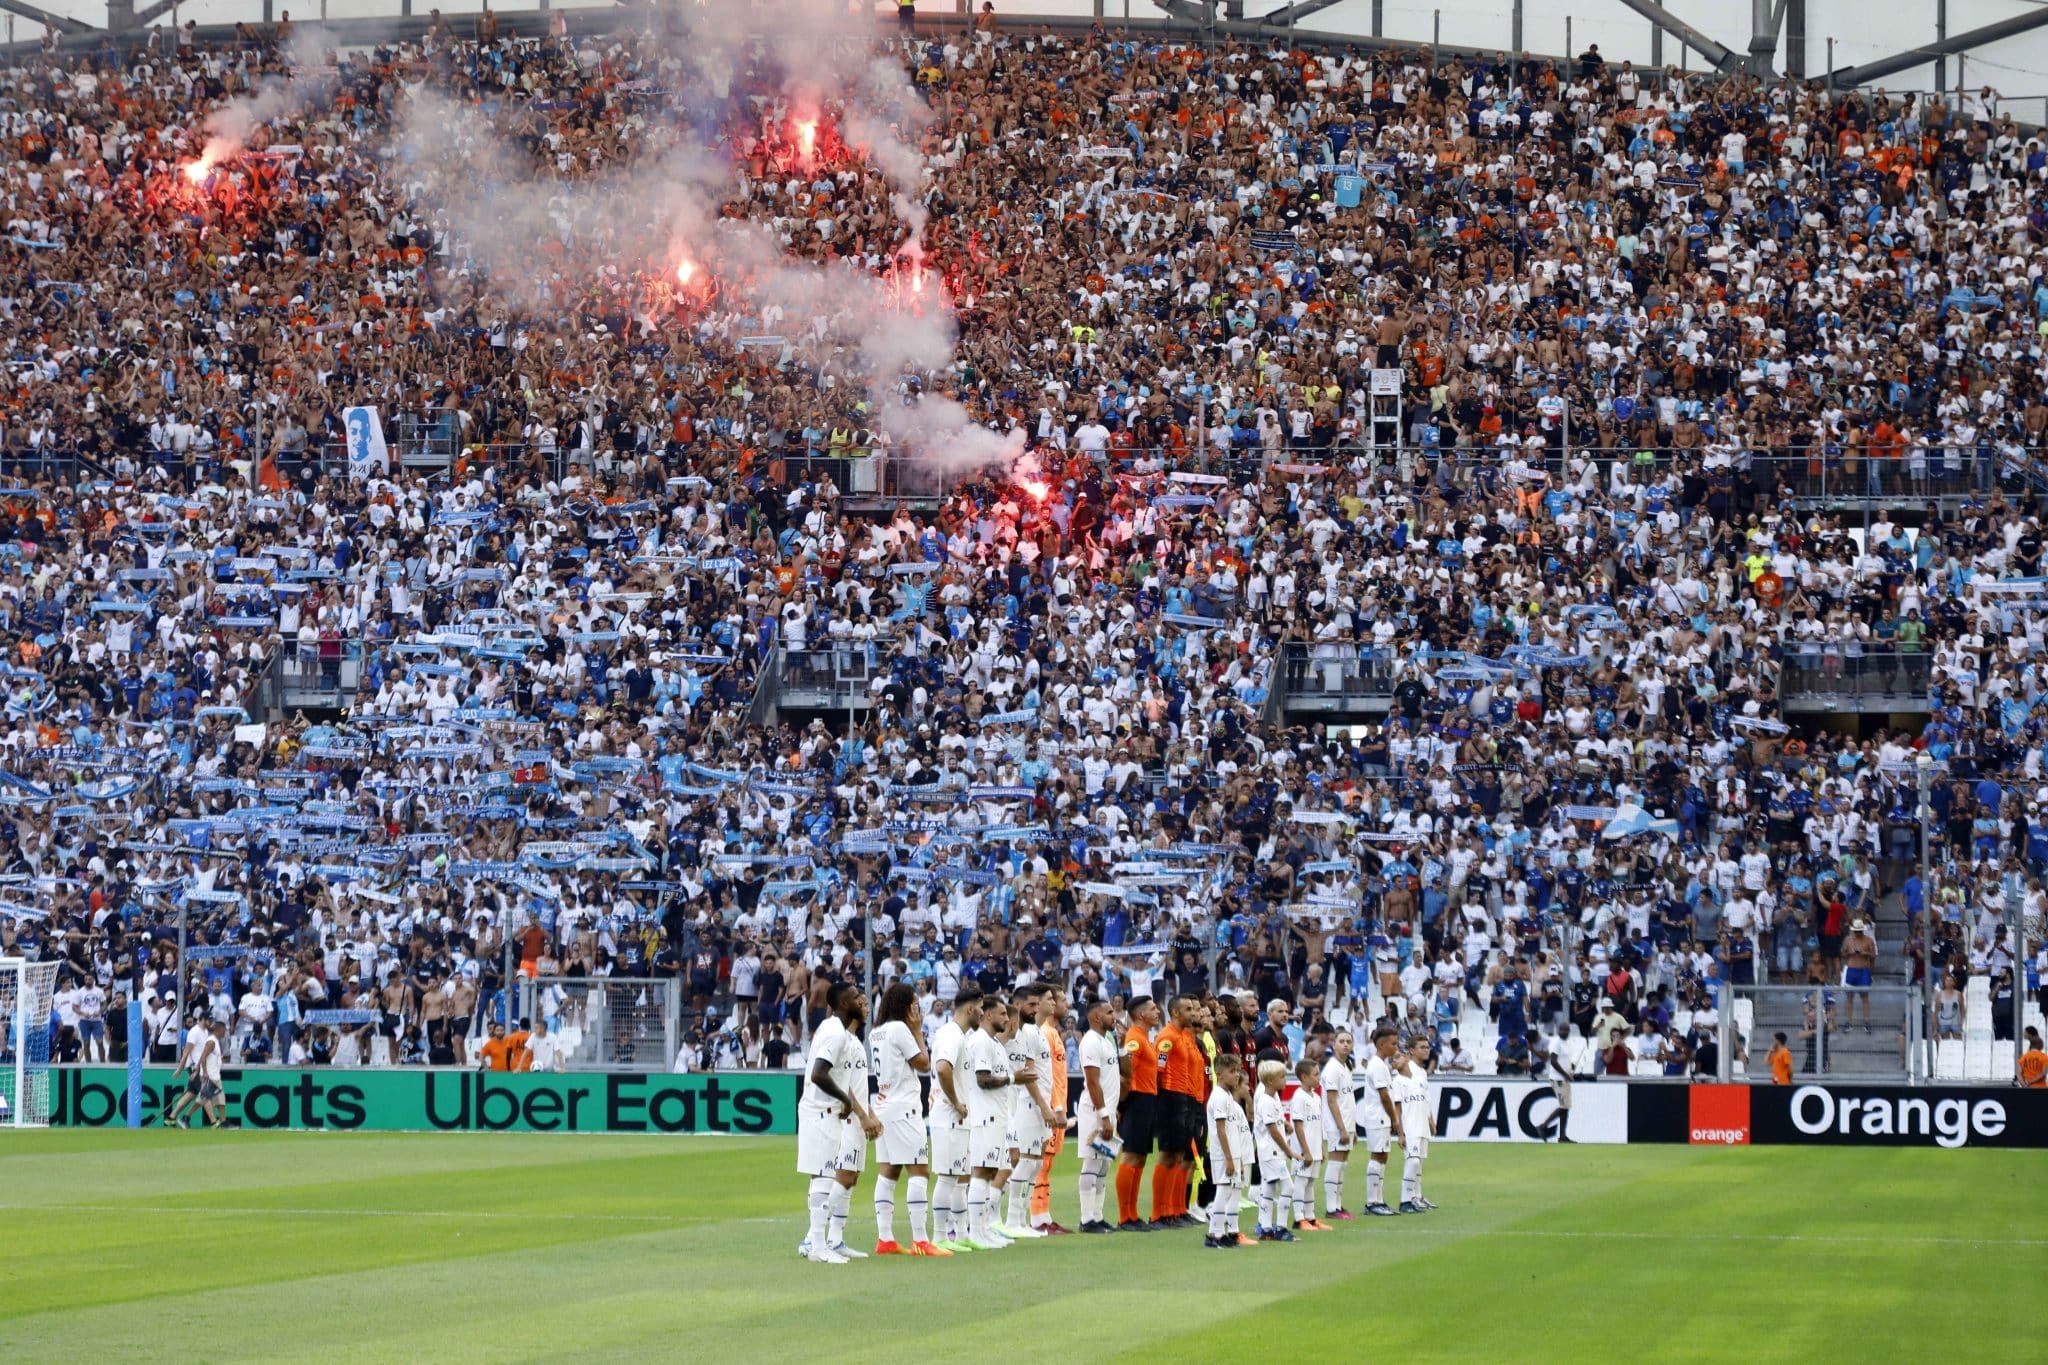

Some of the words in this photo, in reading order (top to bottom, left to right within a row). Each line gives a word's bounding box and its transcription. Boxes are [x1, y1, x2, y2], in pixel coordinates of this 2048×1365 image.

[425, 1071, 589, 1130] Uber
[607, 1075, 773, 1132] Eats
[1790, 1085, 2007, 1148] Orange
[1692, 1128, 1743, 1142] orange
